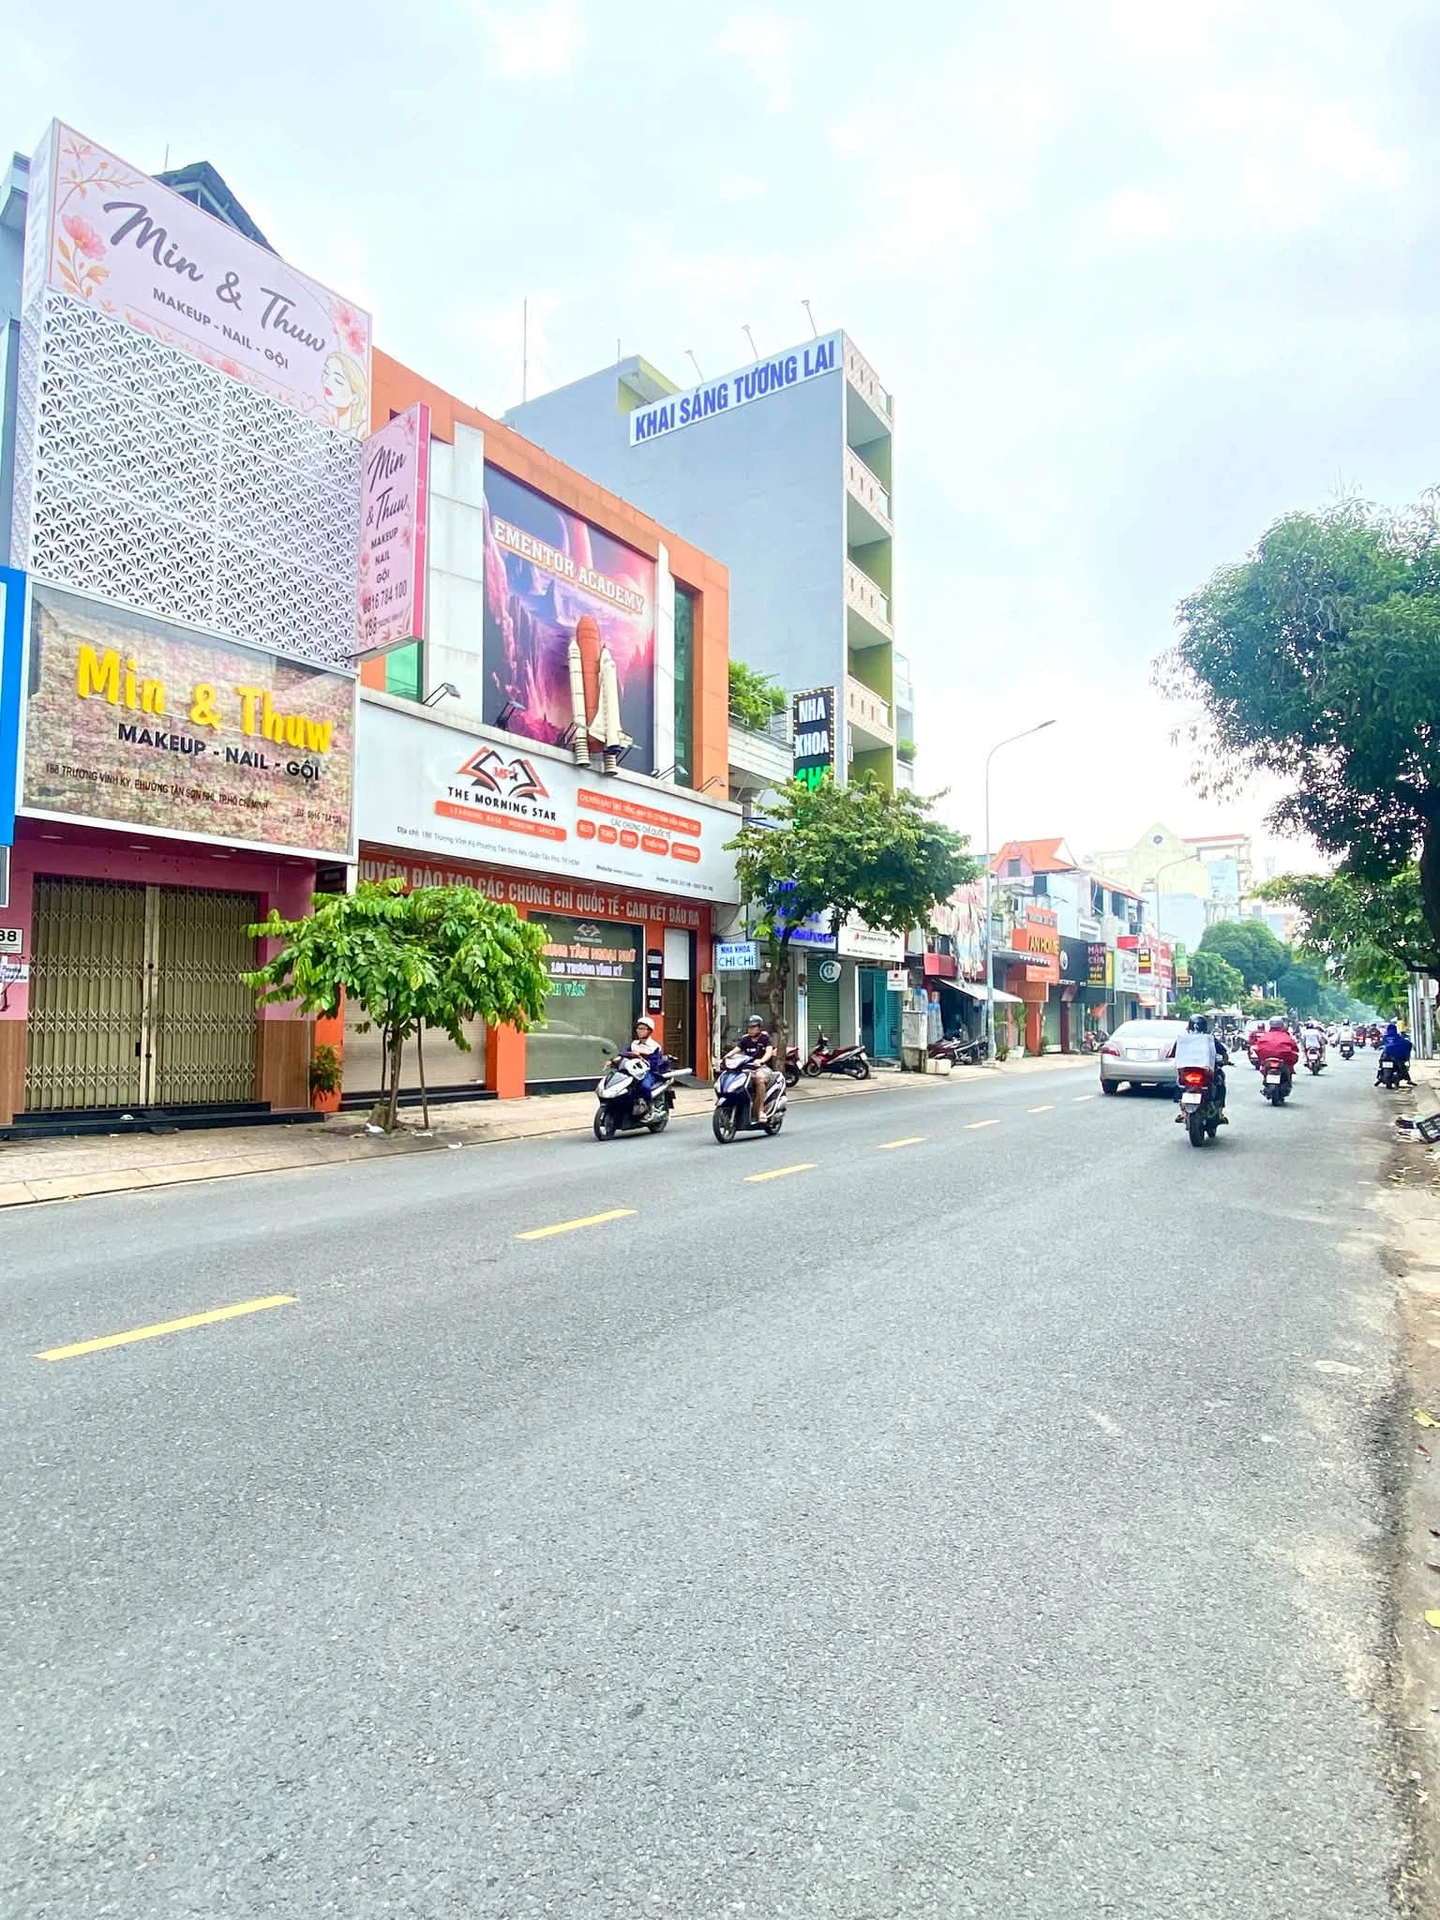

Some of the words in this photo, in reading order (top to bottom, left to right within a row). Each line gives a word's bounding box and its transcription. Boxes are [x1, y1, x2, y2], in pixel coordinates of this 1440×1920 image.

[103, 201, 203, 282] Min
[215, 270, 242, 311] &
[260, 286, 326, 352] Thuw
[153, 287, 211, 325] MAKEUP
[222, 324, 252, 350] NAIL
[264, 348, 289, 370] GỘI
[635, 401, 675, 442] KHAI
[680, 383, 728, 424] SÁNG
[734, 355, 797, 404] TƯƠNG
[804, 340, 834, 378] LAI
[367, 445, 407, 493] Min
[366, 506, 374, 526] &
[376, 486, 408, 530] Thuw
[370, 527, 399, 549] MAKEUP
[375, 551, 391, 566] NAIL
[376, 569, 391, 585] GỘI
[493, 518, 575, 578] EMENTOR
[577, 565, 645, 615] ACADEMY
[77, 643, 166, 715] Min
[190, 683, 222, 731] &
[234, 684, 332, 753] Thuw
[798, 696, 826, 724] NHA
[118, 723, 207, 762] MAKEUP
[225, 746, 270, 770] NAIL
[286, 759, 319, 784] GỘI
[795, 730, 829, 759] KHOA
[448, 786, 470, 801] THE
[474, 794, 528, 815] MORNING
[532, 807, 556, 822] STAR
[412, 865, 443, 888] ĐÀO
[478, 875, 504, 899] CÁC
[508, 882, 551, 906] CHỨNG
[554, 889, 572, 909] CHỈ
[576, 889, 604, 912] QUỐC
[607, 894, 619, 915] TẾ
[626, 901, 647, 919] CAM
[650, 902, 666, 921] KẾT
[689, 910, 700, 926] RA
[719, 956, 735, 967] CHI
[737, 955, 754, 966] CHI
